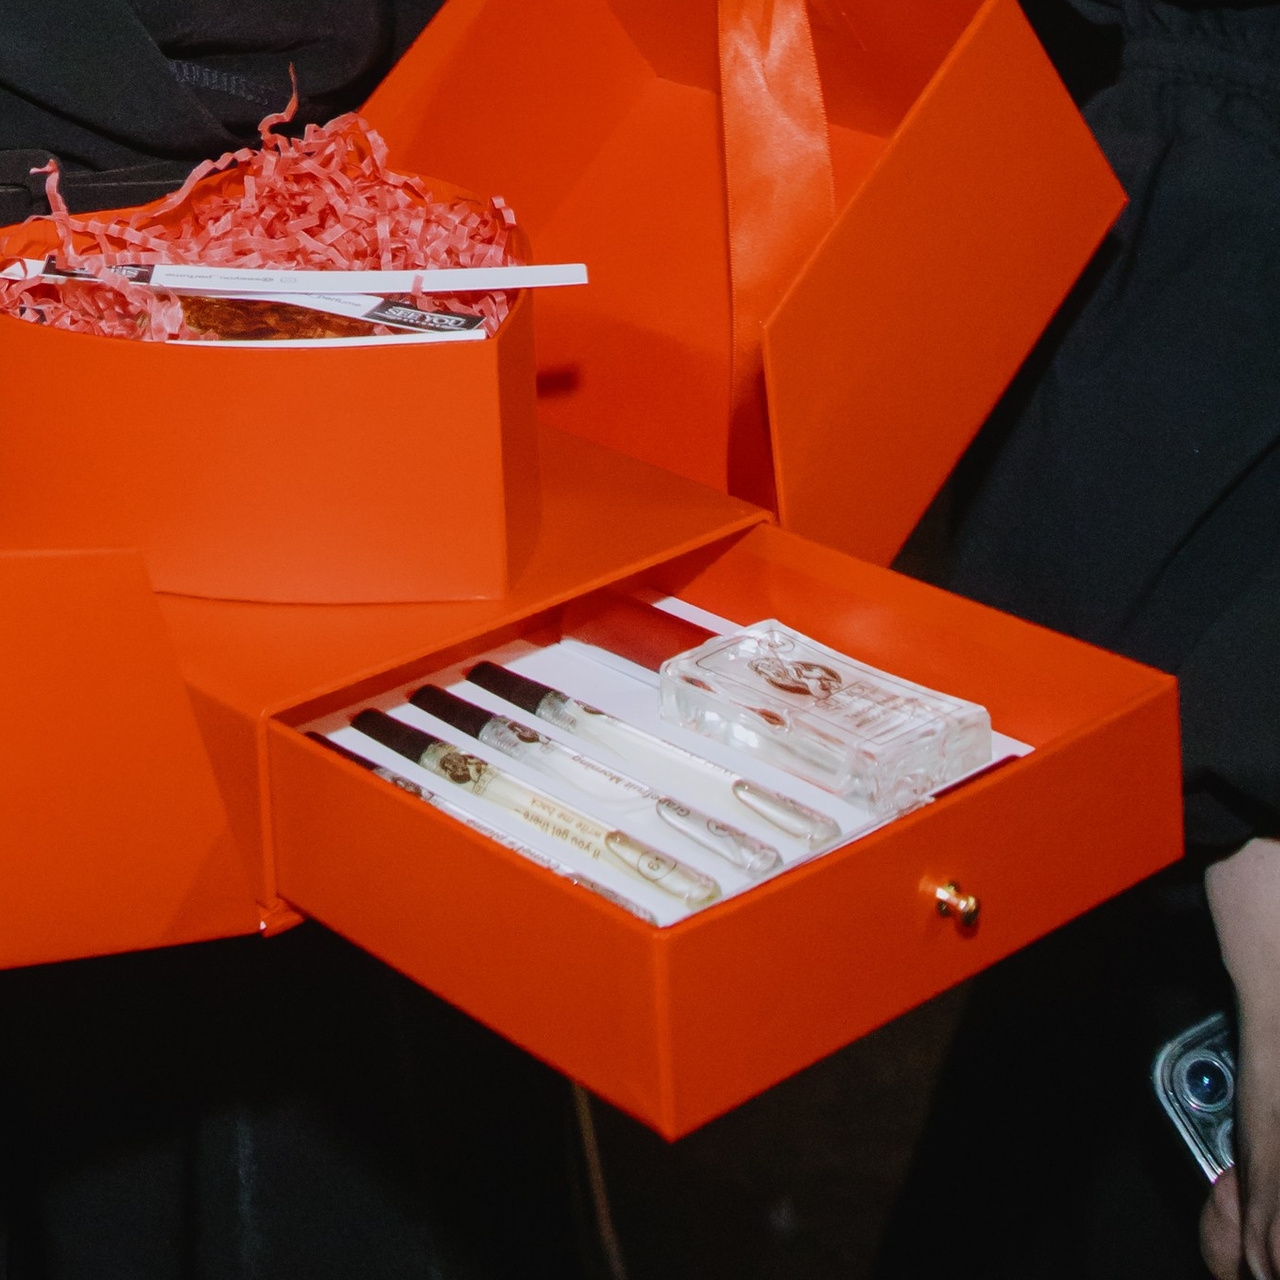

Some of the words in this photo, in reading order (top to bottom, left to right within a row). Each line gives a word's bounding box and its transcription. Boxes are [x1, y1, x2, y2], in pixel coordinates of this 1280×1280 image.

[384, 307, 423, 320] SEE
[421, 312, 464, 327] YOU
[571, 753, 622, 784] Morning
[623, 779, 690, 816] Grapefruit
[529, 798, 556, 816] back
[522, 810, 551, 832] there
[557, 812, 573, 825] me
[551, 825, 571, 841] get
[575, 820, 602, 838] write
[570, 835, 592, 852] you
